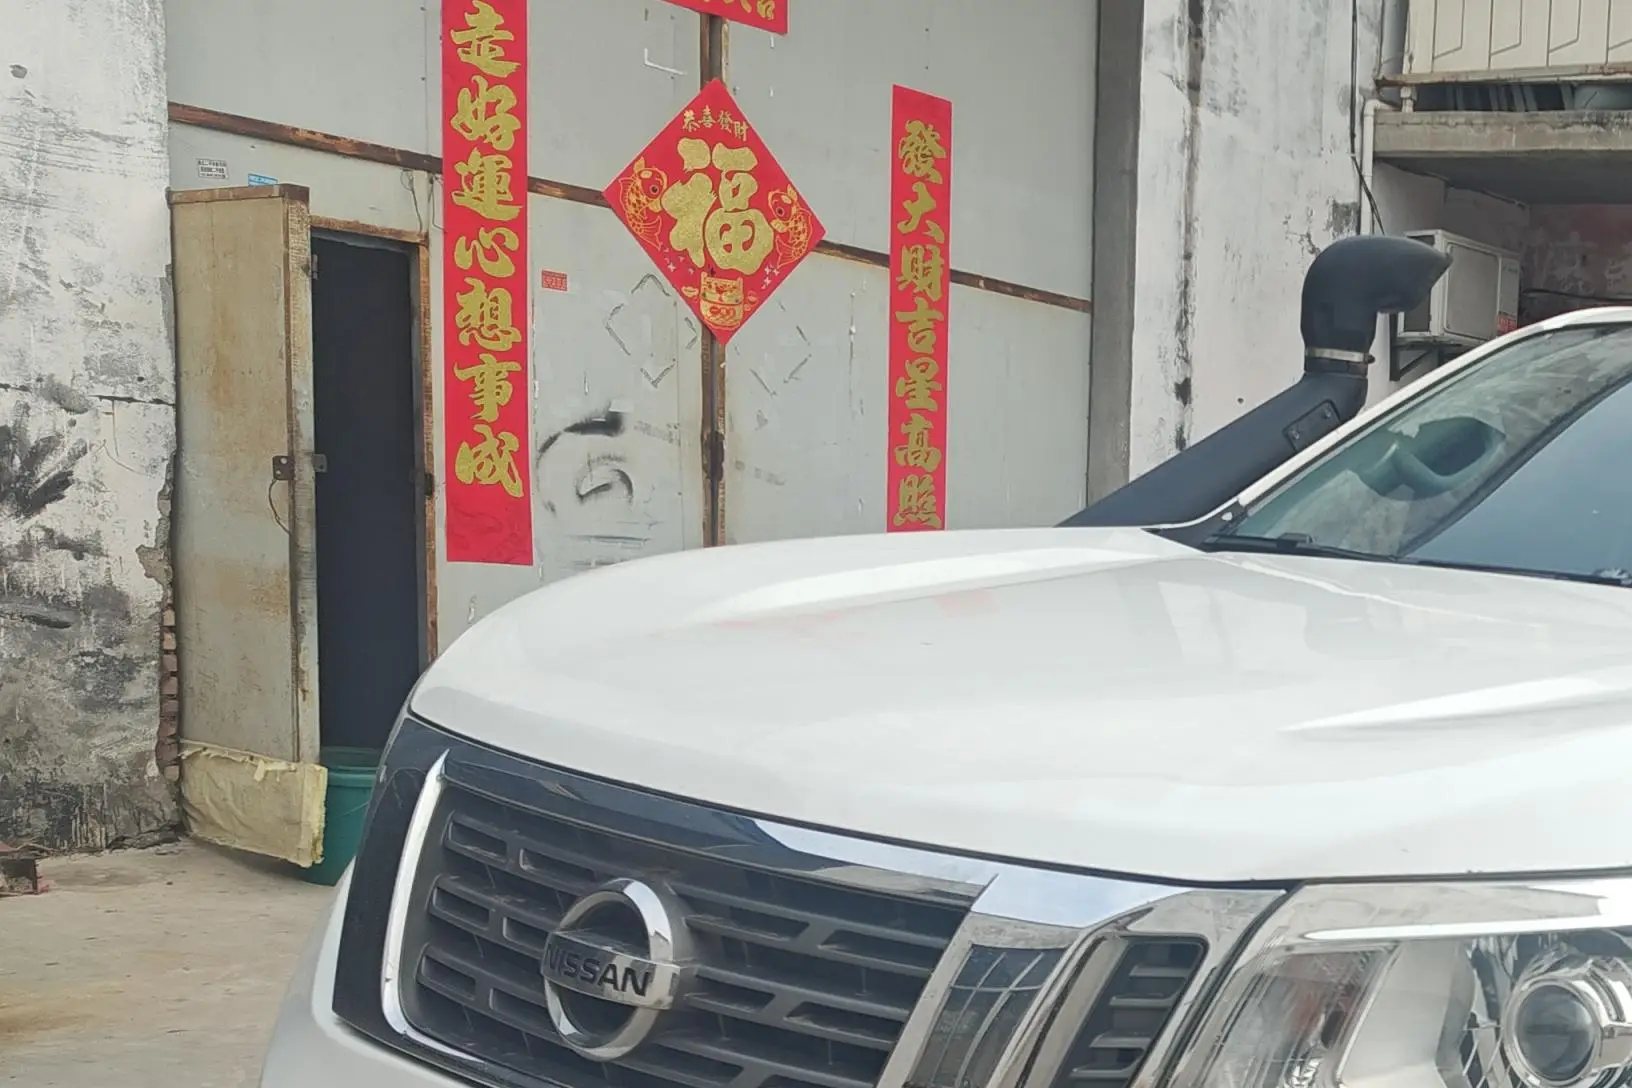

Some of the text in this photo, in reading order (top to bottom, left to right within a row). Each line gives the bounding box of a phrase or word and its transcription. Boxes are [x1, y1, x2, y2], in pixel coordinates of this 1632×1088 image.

[681, 105, 749, 142] 恭喜發財
[661, 137, 774, 275] 福
[549, 947, 652, 997] NISSAN
